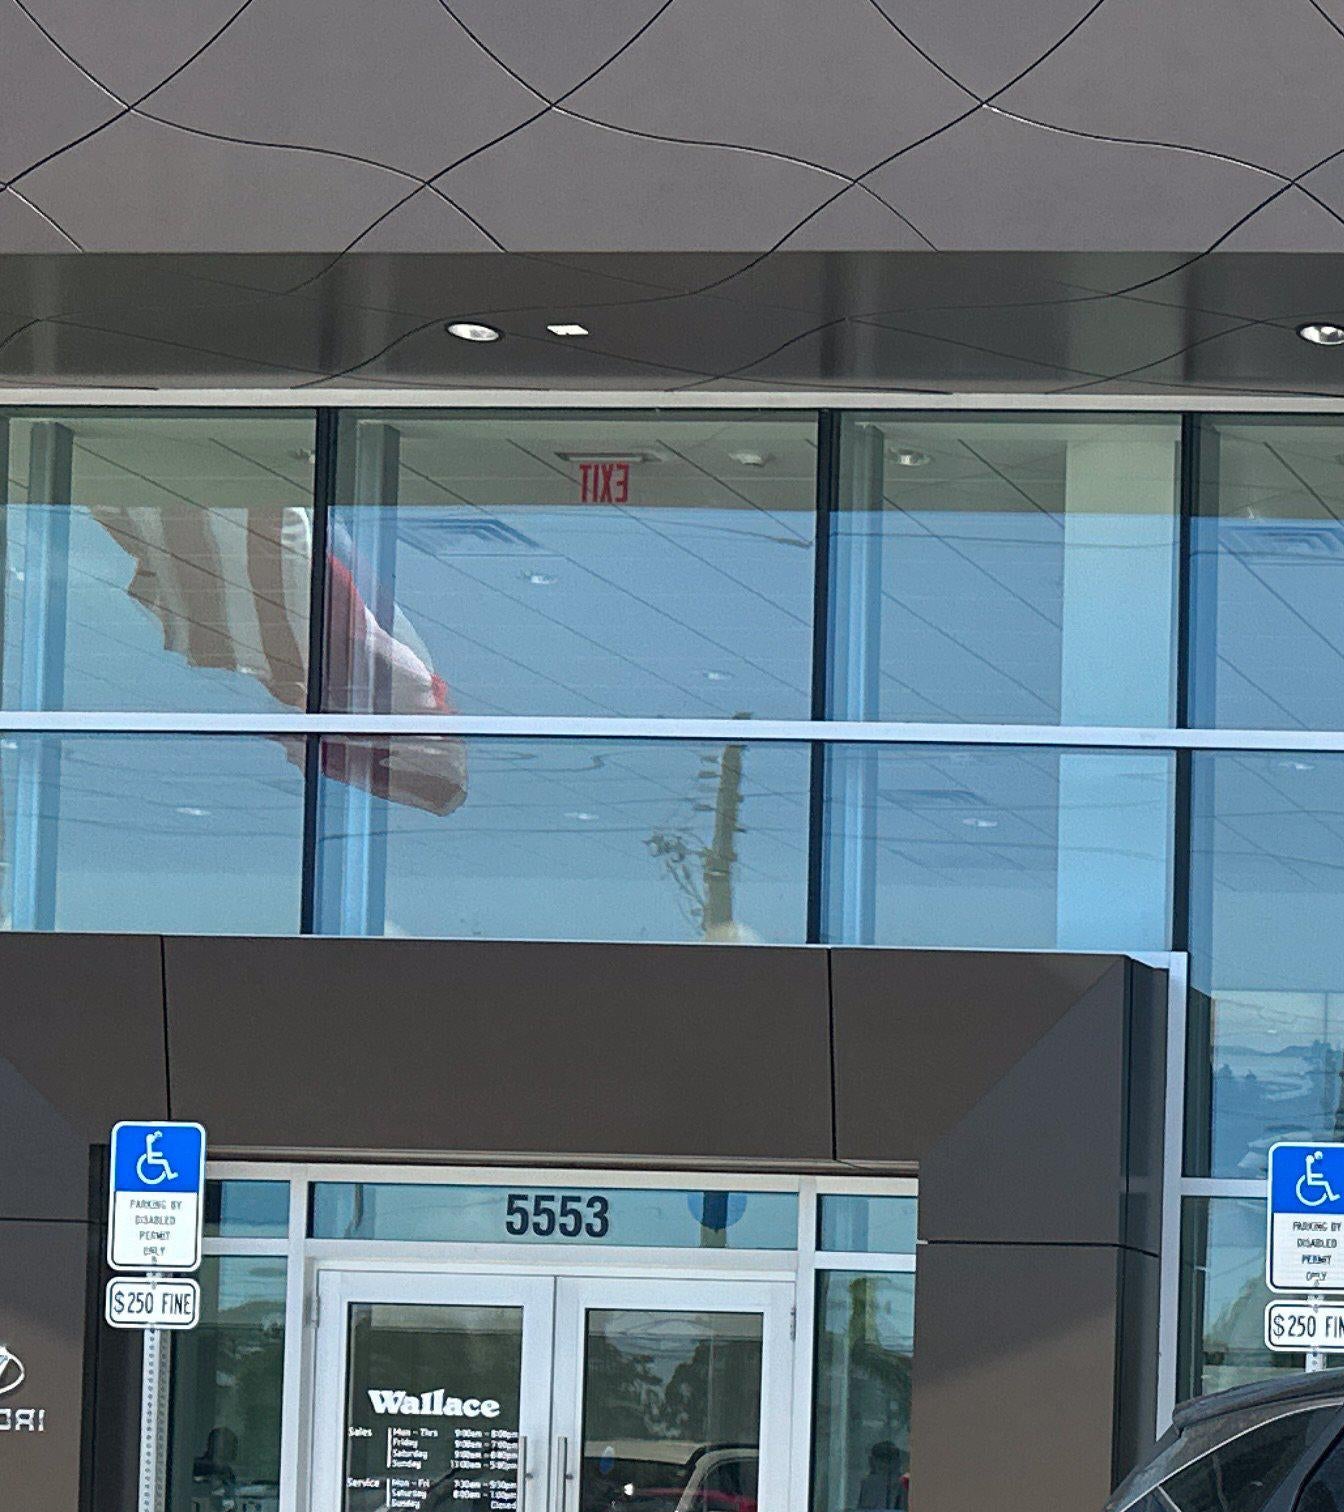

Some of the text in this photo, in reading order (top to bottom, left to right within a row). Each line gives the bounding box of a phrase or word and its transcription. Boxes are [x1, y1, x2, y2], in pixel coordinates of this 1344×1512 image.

[130, 1200, 182, 1210] PARKING BY
[135, 1215, 176, 1225] DISABLED
[506, 1194, 609, 1238] 5553
[1293, 1221, 1342, 1231] PARKING BY
[140, 1231, 170, 1240] PERMIT
[1297, 1239, 1337, 1248] DISABLED
[1302, 1255, 1332, 1264] PERMIT
[114, 1291, 191, 1315] $250 FINE
[1273, 1313, 1316, 1339] $250
[368, 1389, 500, 1418] Wallace
[348, 1427, 372, 1436] Sales
[347, 1478, 379, 1487] Service
